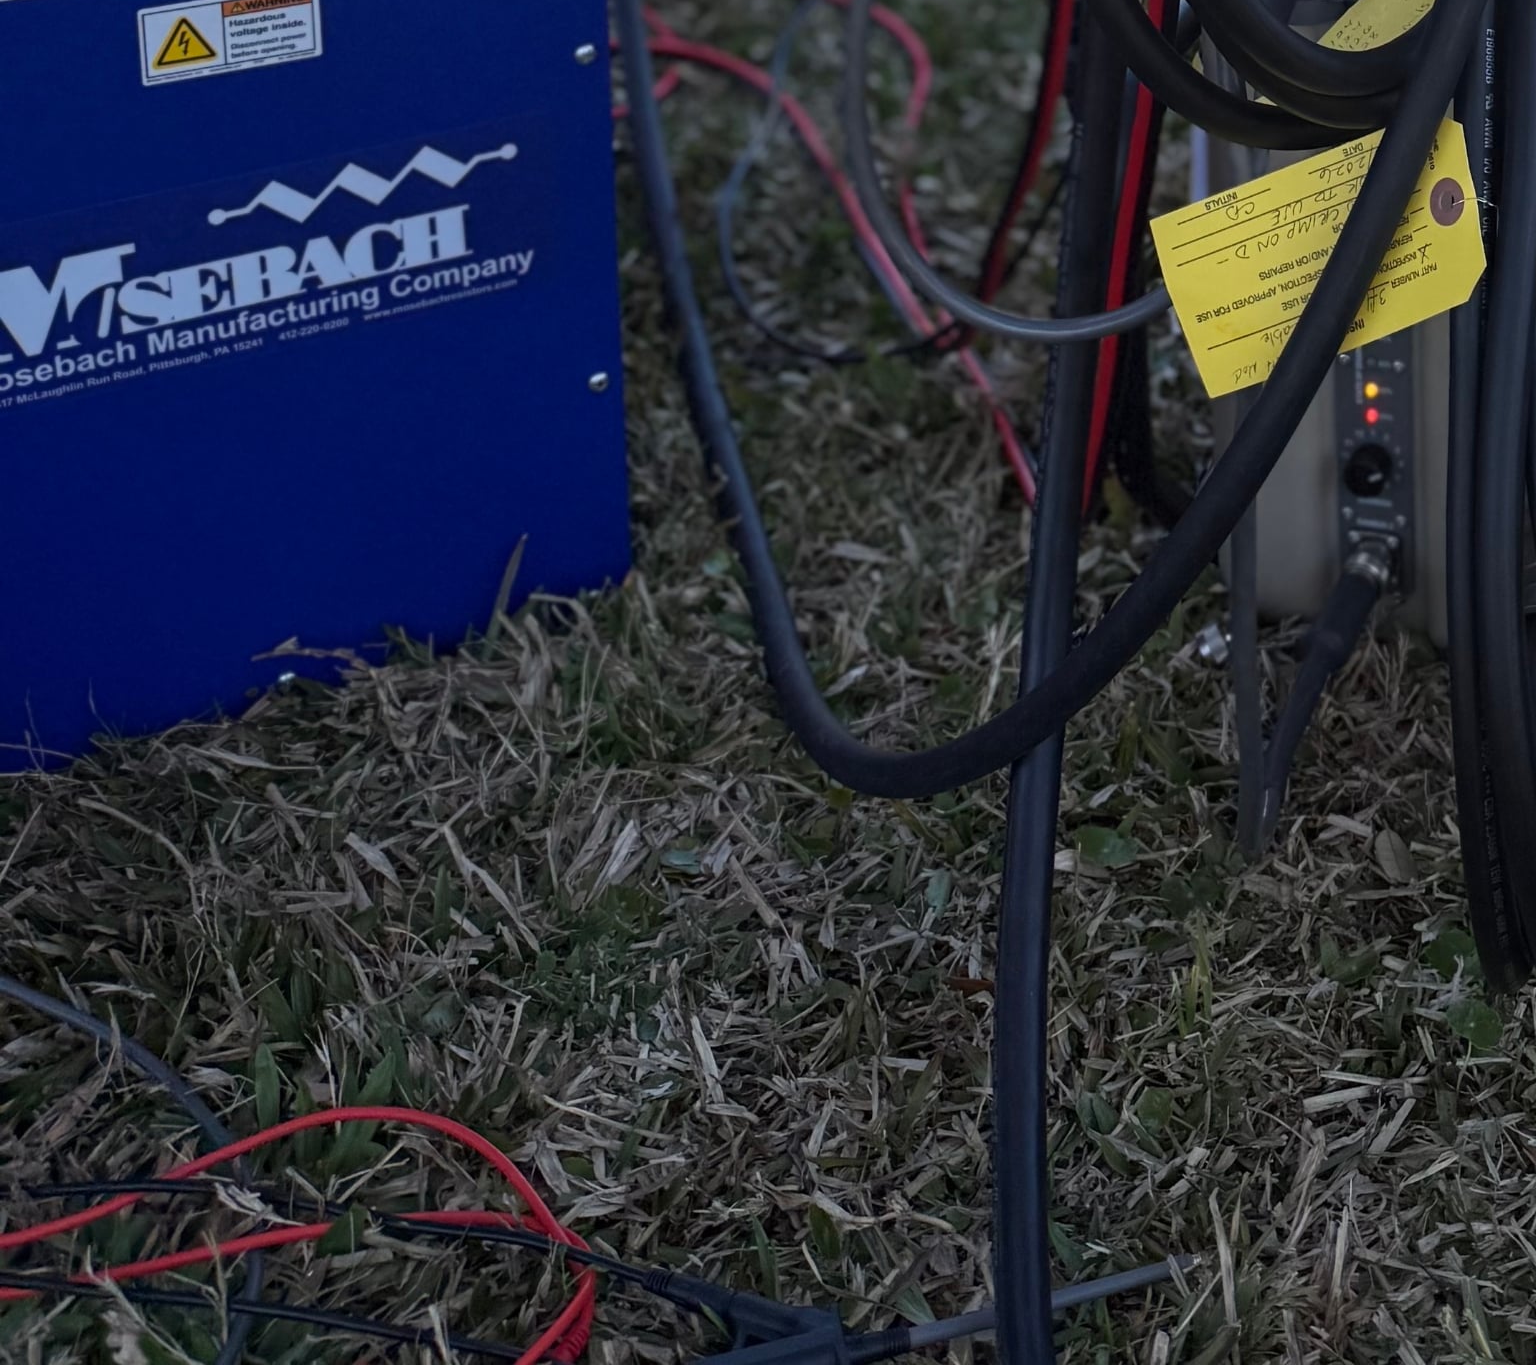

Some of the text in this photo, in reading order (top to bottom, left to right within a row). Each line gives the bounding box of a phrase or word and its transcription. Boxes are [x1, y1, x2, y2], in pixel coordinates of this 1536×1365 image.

[229, 12, 286, 28] Hazardous
[230, 19, 307, 38] voltage inside.
[230, 32, 307, 50] Disconnect power
[231, 43, 297, 59] before opening.
[1342, 142, 1363, 156] DATE
[1204, 191, 1238, 211] INITIALS
[1259, 246, 1331, 281] AND/OR REPAIRS
[1391, 262, 1438, 289] PART NUMBER
[147, 285, 380, 356] Manufacturing
[389, 249, 534, 298] Company
[1196, 285, 1277, 323] APPROVED FOR USE
[1282, 298, 1299, 311] USE
[16, 278, 518, 404] McLaughlin Run Road, Pittsburgh, PA 15241 412-220-0200 www.mosebachresistors.com
